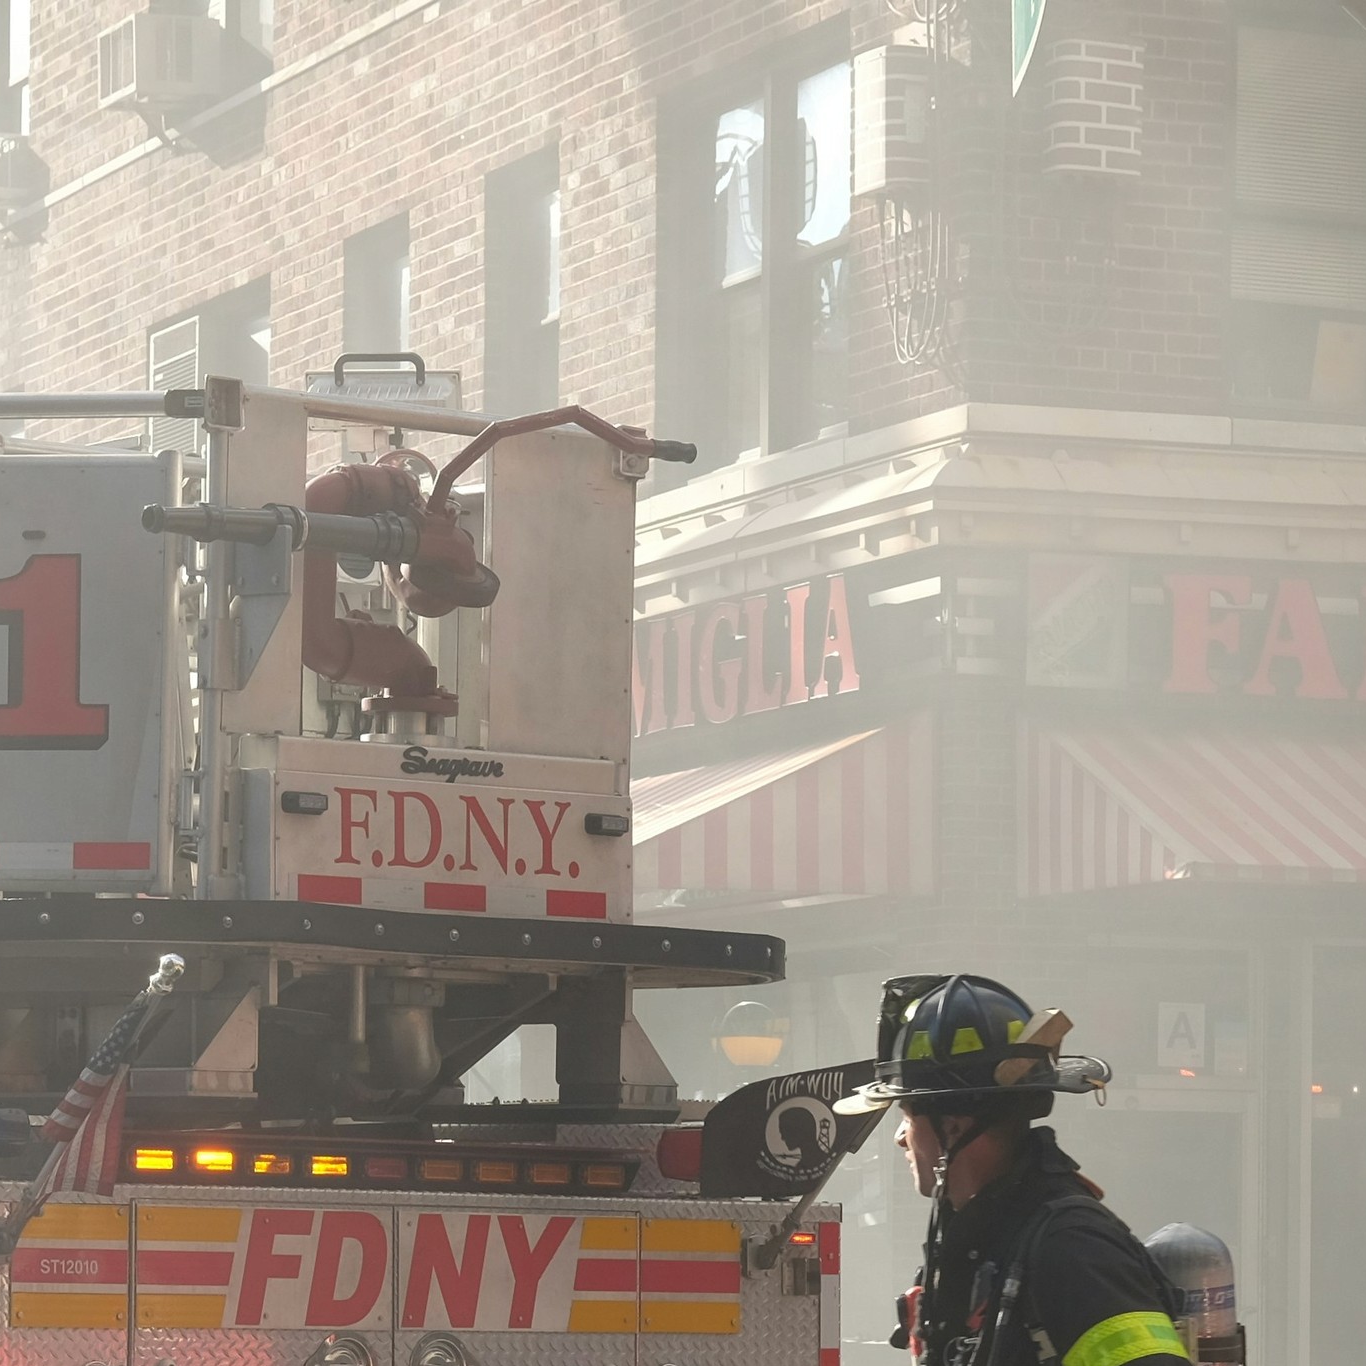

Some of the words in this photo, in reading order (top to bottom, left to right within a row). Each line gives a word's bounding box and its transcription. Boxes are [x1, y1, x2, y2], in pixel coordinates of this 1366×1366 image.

[400, 746, 505, 783] Seagrave
[334, 786, 581, 879] F.D.N.Y.
[1165, 1011, 1197, 1049] A
[40, 1258, 99, 1275] ST12010
[235, 1209, 576, 1328] FDNY
